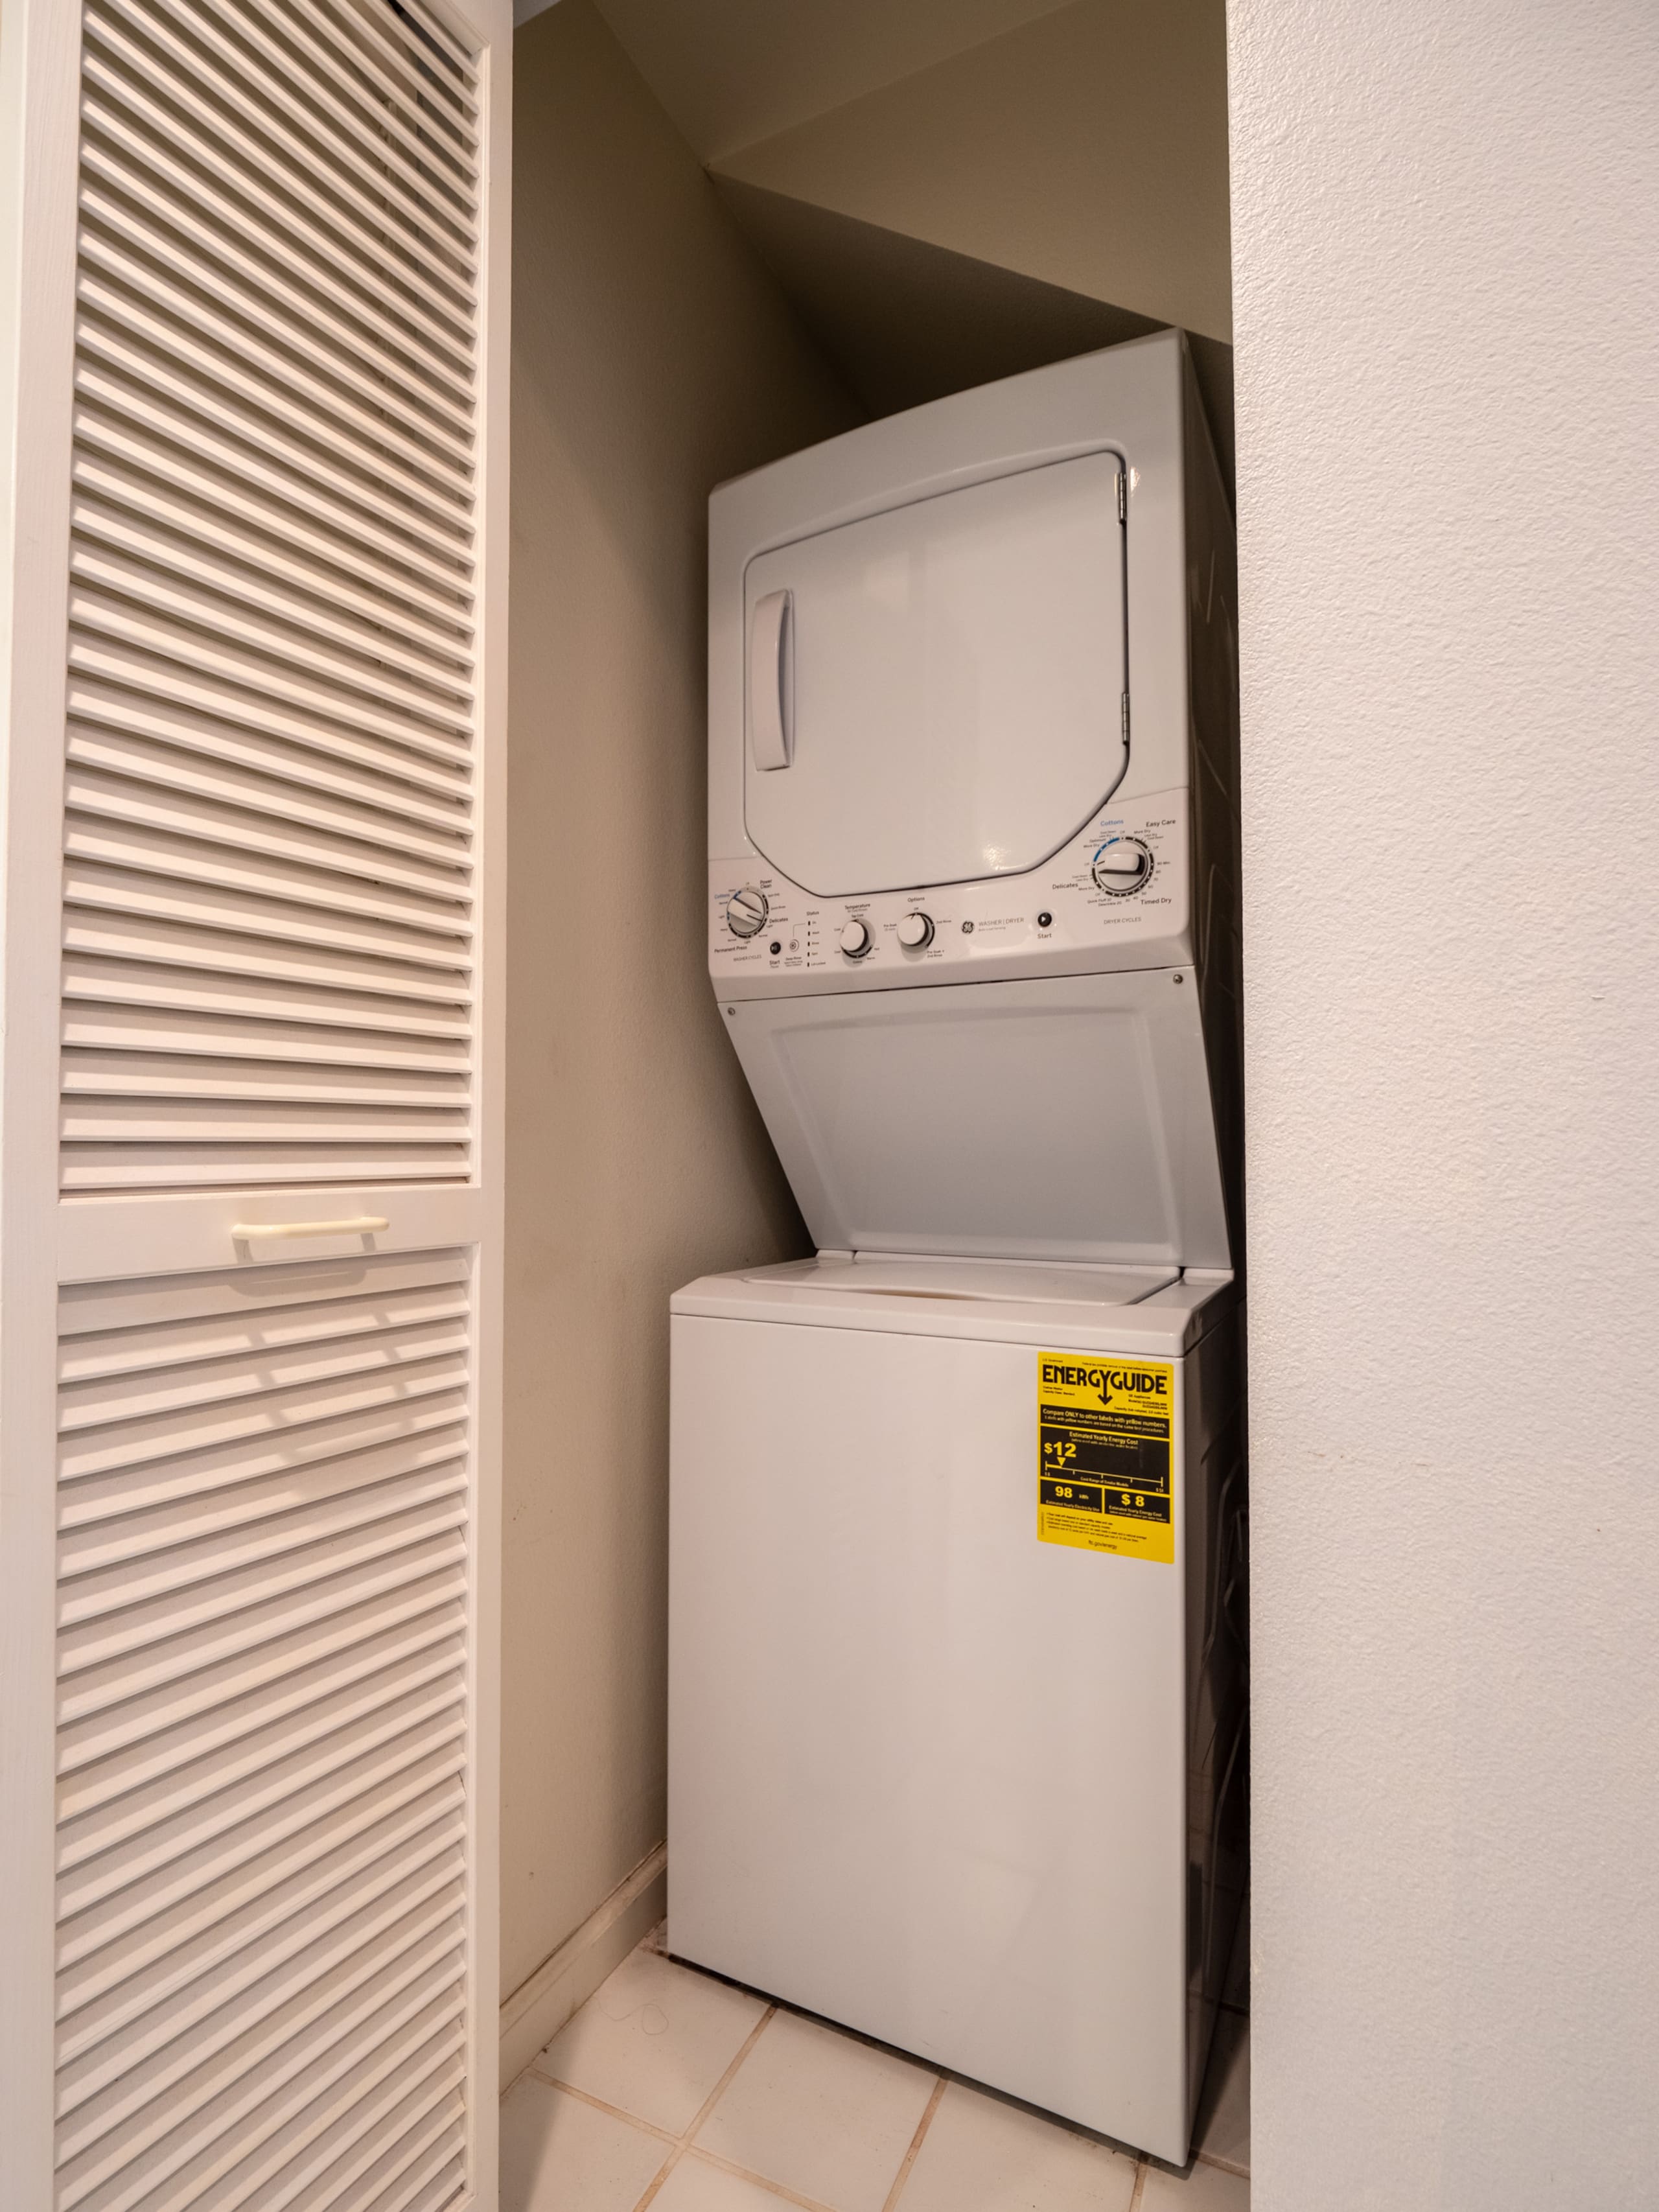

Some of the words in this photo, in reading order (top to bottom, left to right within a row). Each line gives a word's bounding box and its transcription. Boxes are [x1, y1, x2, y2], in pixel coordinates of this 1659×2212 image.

[1043, 1364, 1167, 1395] ENERGYGUIDE
[1044, 1441, 1076, 1458] $12
[1055, 1486, 1073, 1498] 98
[1121, 1493, 1131, 1506] $
[1135, 1495, 1144, 1507] 8
